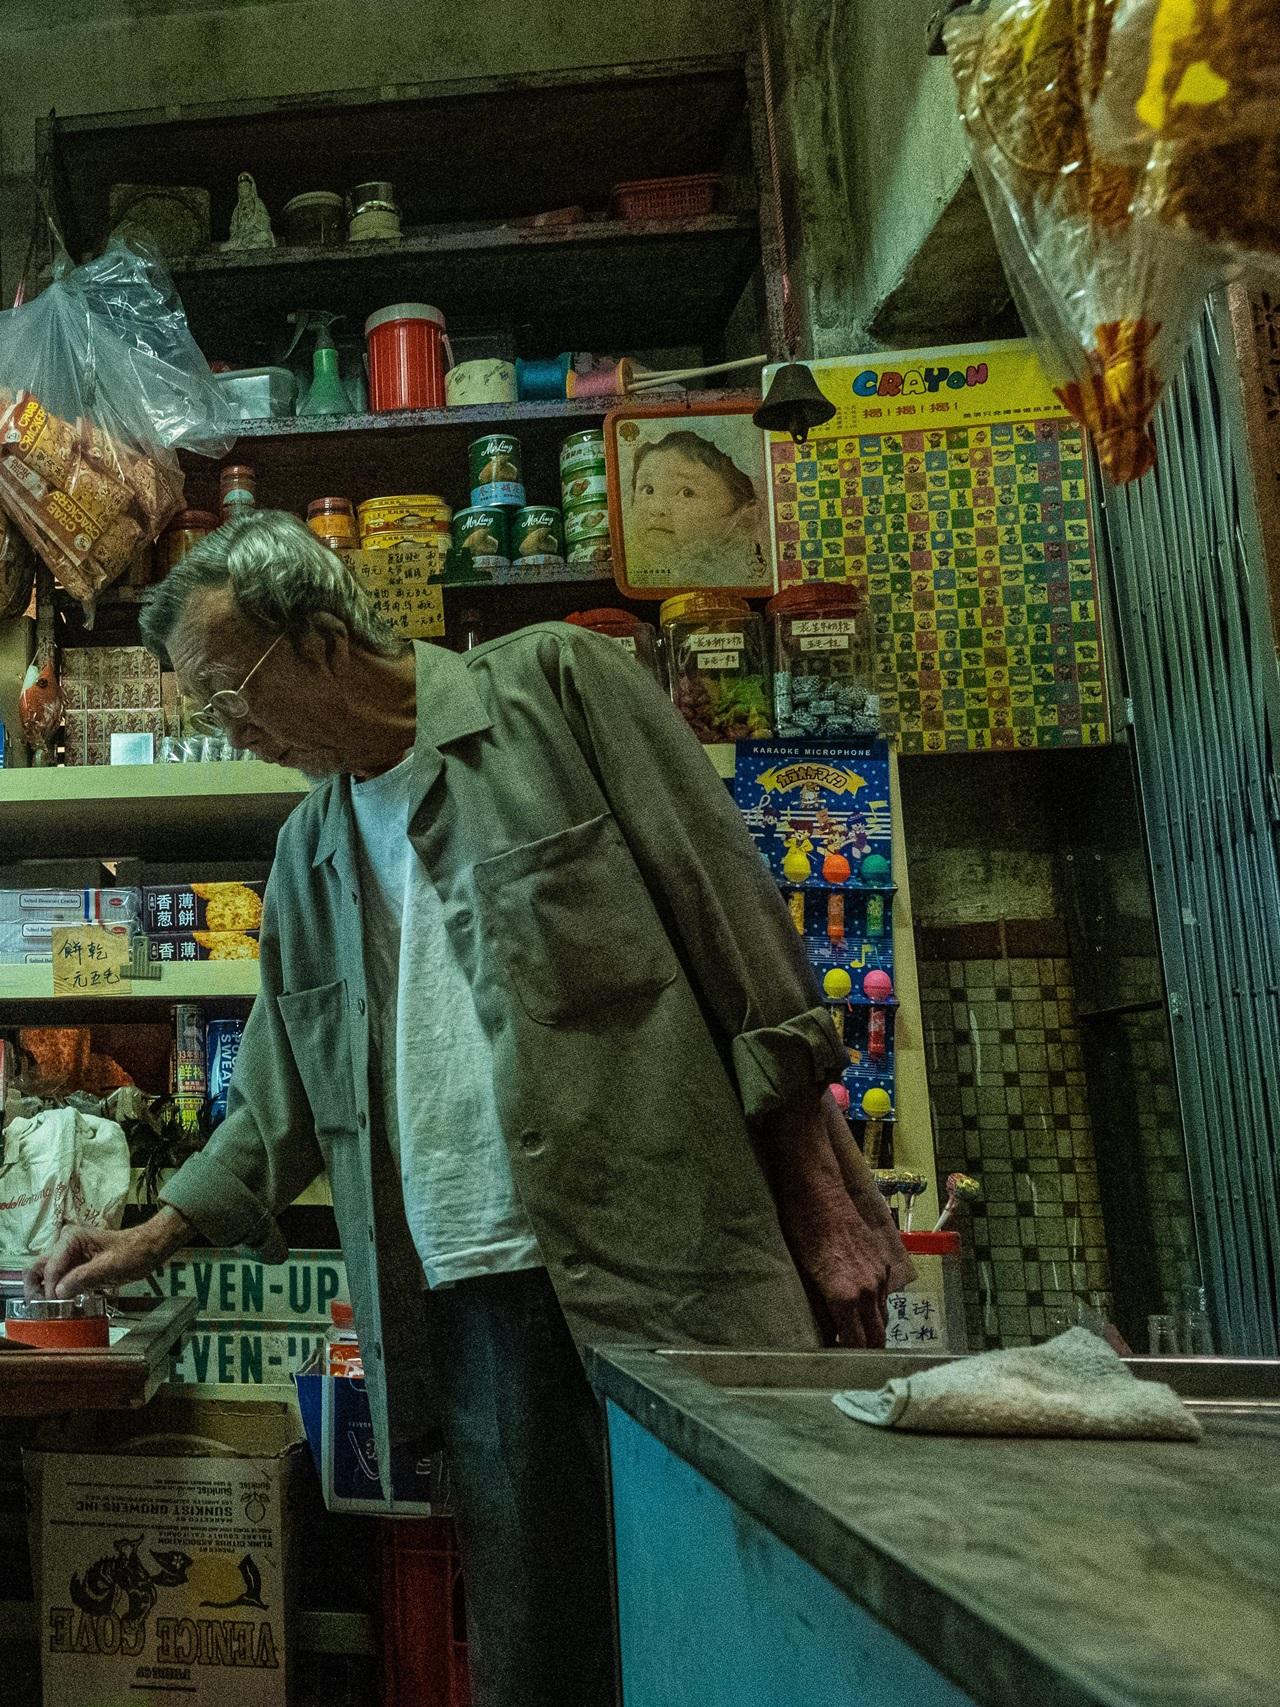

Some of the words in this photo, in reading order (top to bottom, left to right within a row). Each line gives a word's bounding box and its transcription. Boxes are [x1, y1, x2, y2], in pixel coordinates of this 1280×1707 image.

[852, 363, 989, 397] CRAYON
[17, 401, 39, 427] CRAB
[47, 501, 76, 532] CRAB
[752, 745, 800, 756] KARAOKE
[804, 747, 872, 757] MICROPHONE
[776, 766, 848, 789] カラオケマイク
[178, 892, 195, 927] 薄餅
[57, 939, 108, 966] 餅乾
[158, 942, 175, 961] 香
[180, 941, 197, 961] 薄
[62, 971, 121, 989] 一元五毛
[886, 1324, 936, 1342] 毛一粒
[197, 1486, 232, 1497] Sunkist
[101, 1502, 169, 1515] GROWERS
[174, 1505, 233, 1517] SUNKIST
[158, 1538, 213, 1547] ASSOCIATION
[156, 1616, 279, 1669] VENICE
